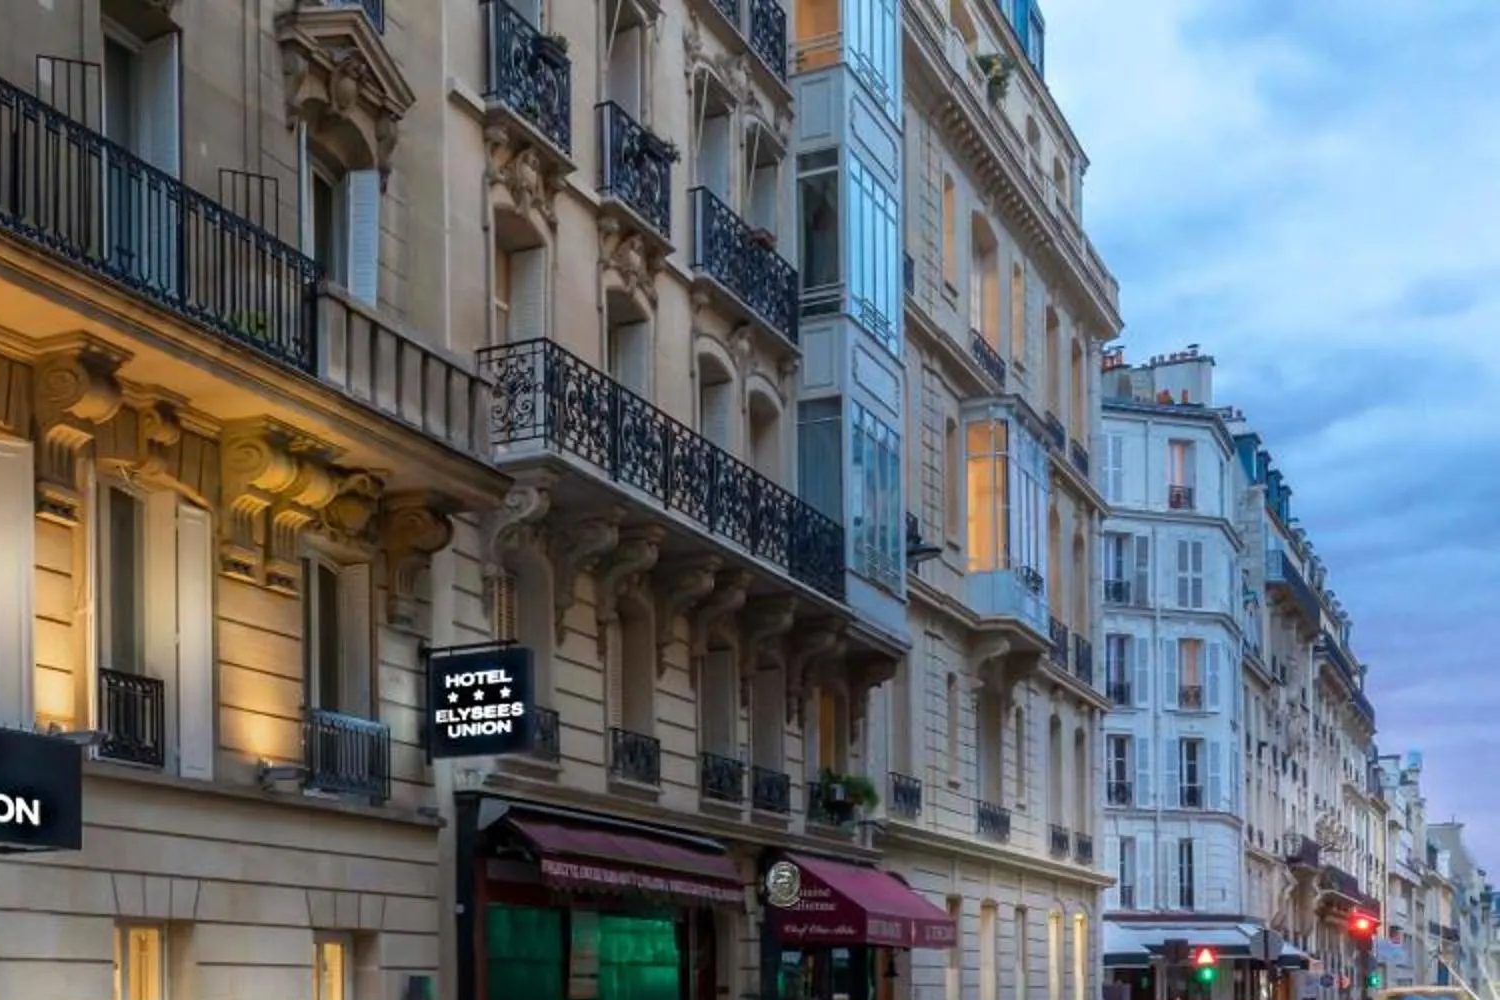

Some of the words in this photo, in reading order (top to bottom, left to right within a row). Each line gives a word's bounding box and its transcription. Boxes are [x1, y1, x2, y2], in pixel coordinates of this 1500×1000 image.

[445, 669, 513, 688] HOTEL
[435, 701, 524, 723] ELYSEES
[447, 719, 512, 738] UNION
